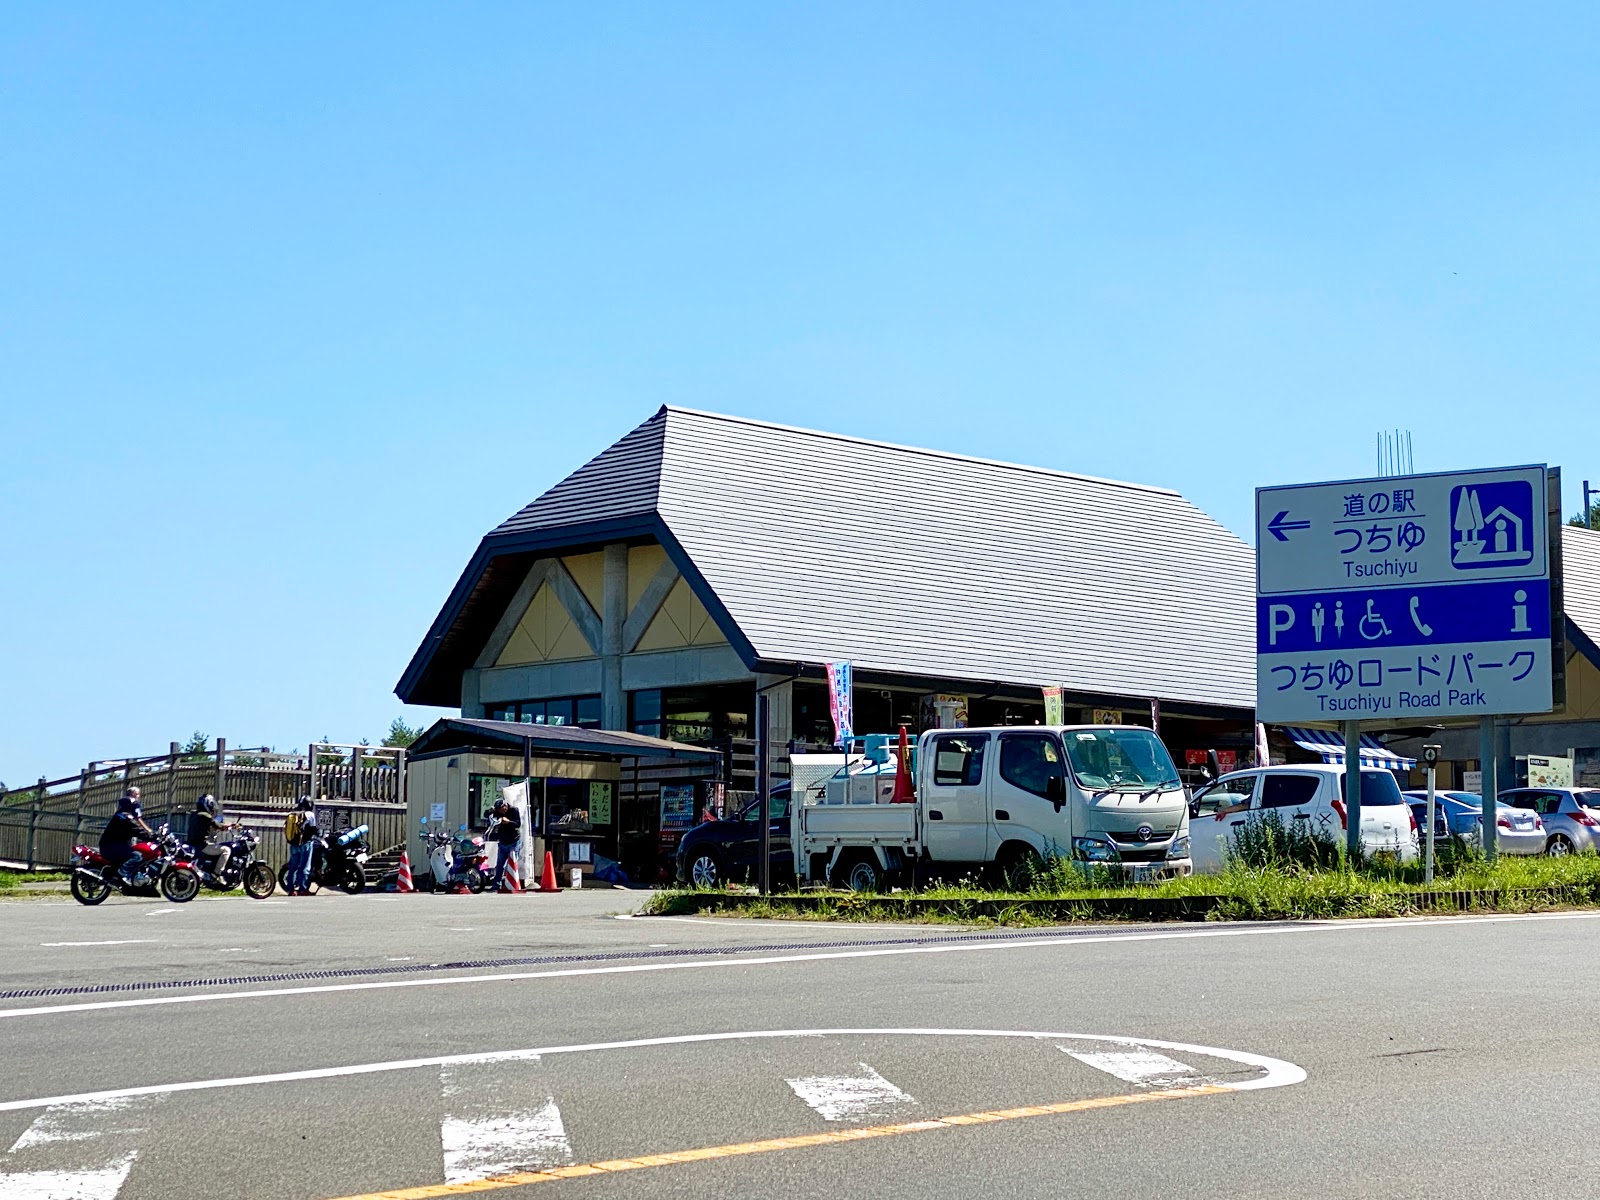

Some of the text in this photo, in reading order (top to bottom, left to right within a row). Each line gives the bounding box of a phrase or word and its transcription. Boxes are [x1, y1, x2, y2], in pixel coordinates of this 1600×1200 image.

[1343, 489, 1416, 517] 道の駅
[1333, 521, 1426, 554] つちゆ
[1343, 559, 1418, 578] Tsuchiyu
[1270, 651, 1535, 692] つちゆロードパーク
[1317, 688, 1487, 712] Tsuchiyu Road Park
